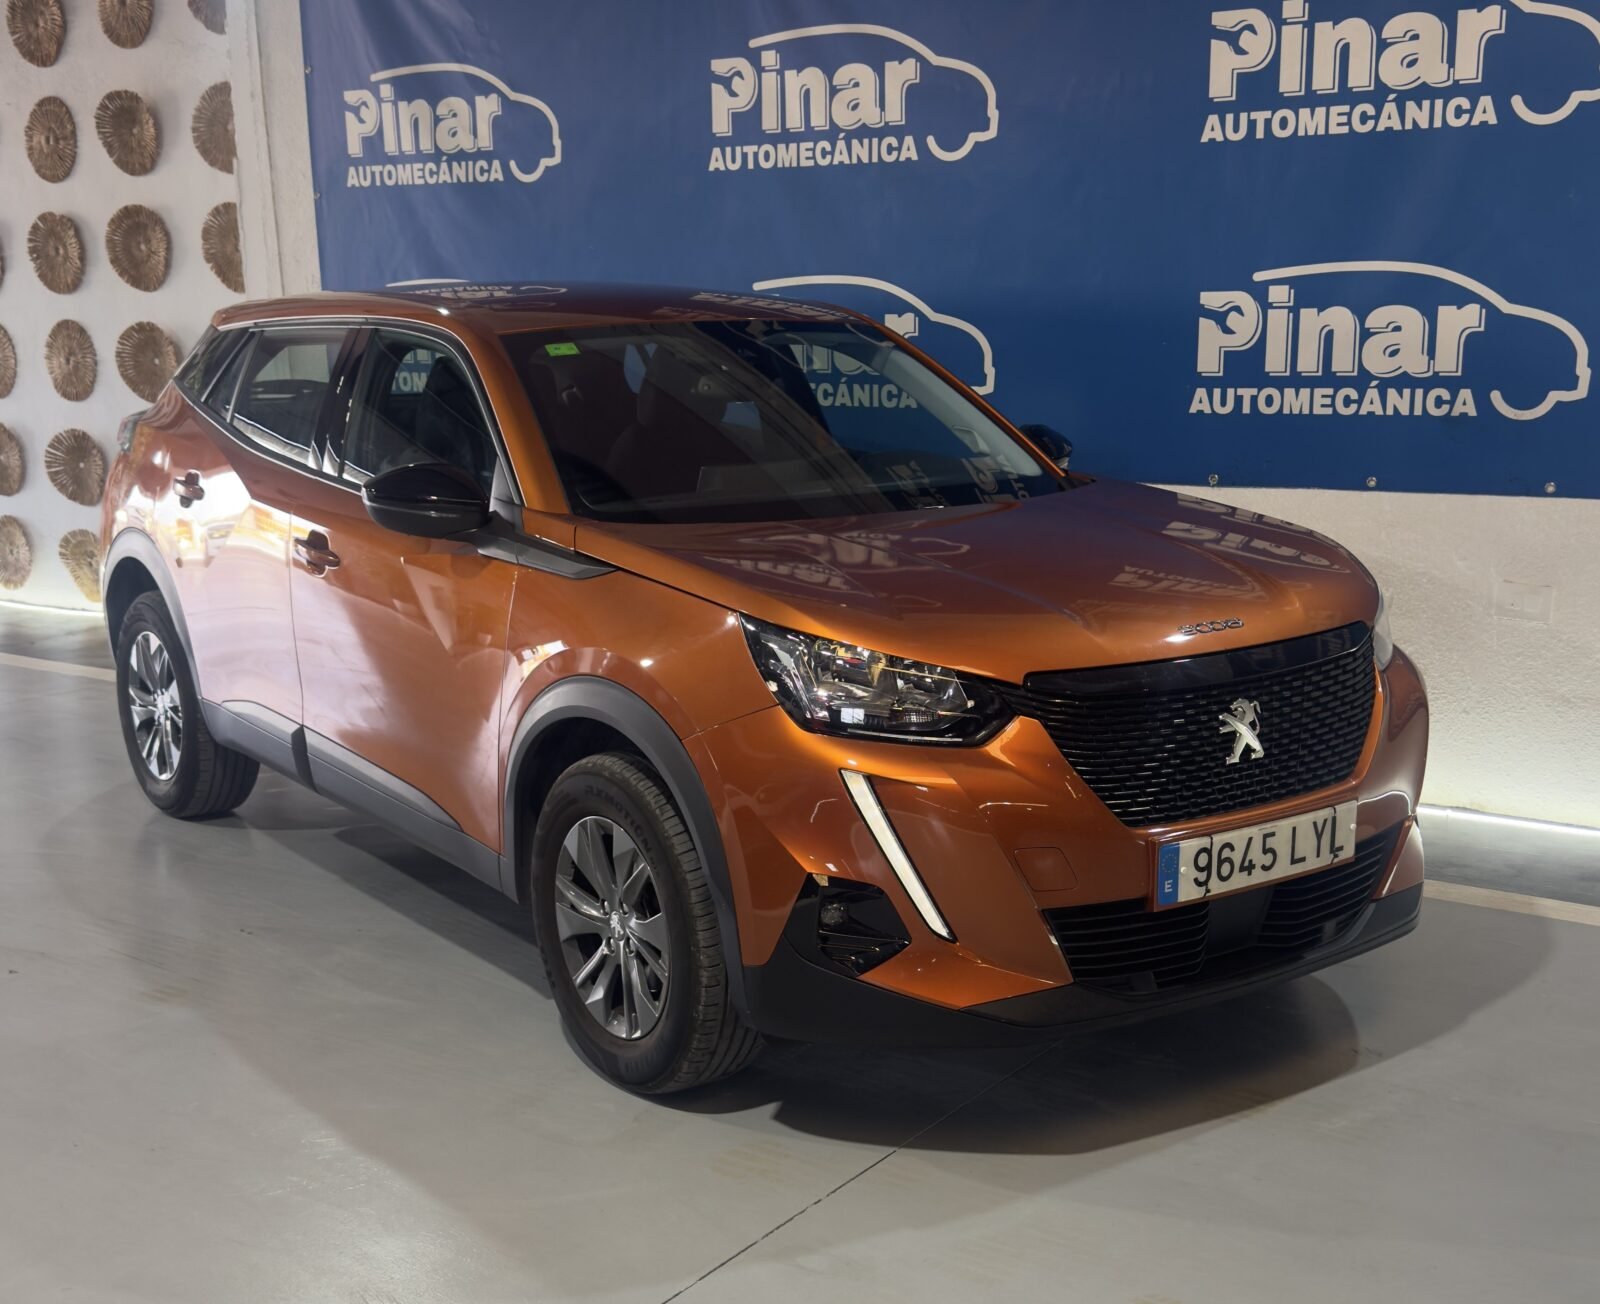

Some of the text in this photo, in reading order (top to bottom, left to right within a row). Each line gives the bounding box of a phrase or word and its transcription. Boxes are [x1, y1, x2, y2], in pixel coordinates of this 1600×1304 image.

[1208, 0, 1506, 102] Pinar
[710, 50, 919, 136] Pinar
[343, 84, 502, 157] Pinar
[1200, 94, 1498, 143] AUTOMECÁNICA
[347, 157, 504, 188] AUTOMECÁNICA
[708, 133, 918, 172] AUTOMECÁNICA
[1196, 284, 1485, 378] Pinar
[811, 376, 918, 409] CÁNICA
[1189, 380, 1477, 417] AUTOMECÁNICA
[1177, 616, 1244, 636] 2008
[1193, 814, 1344, 888] 9645 LYL
[1164, 879, 1173, 893] E
